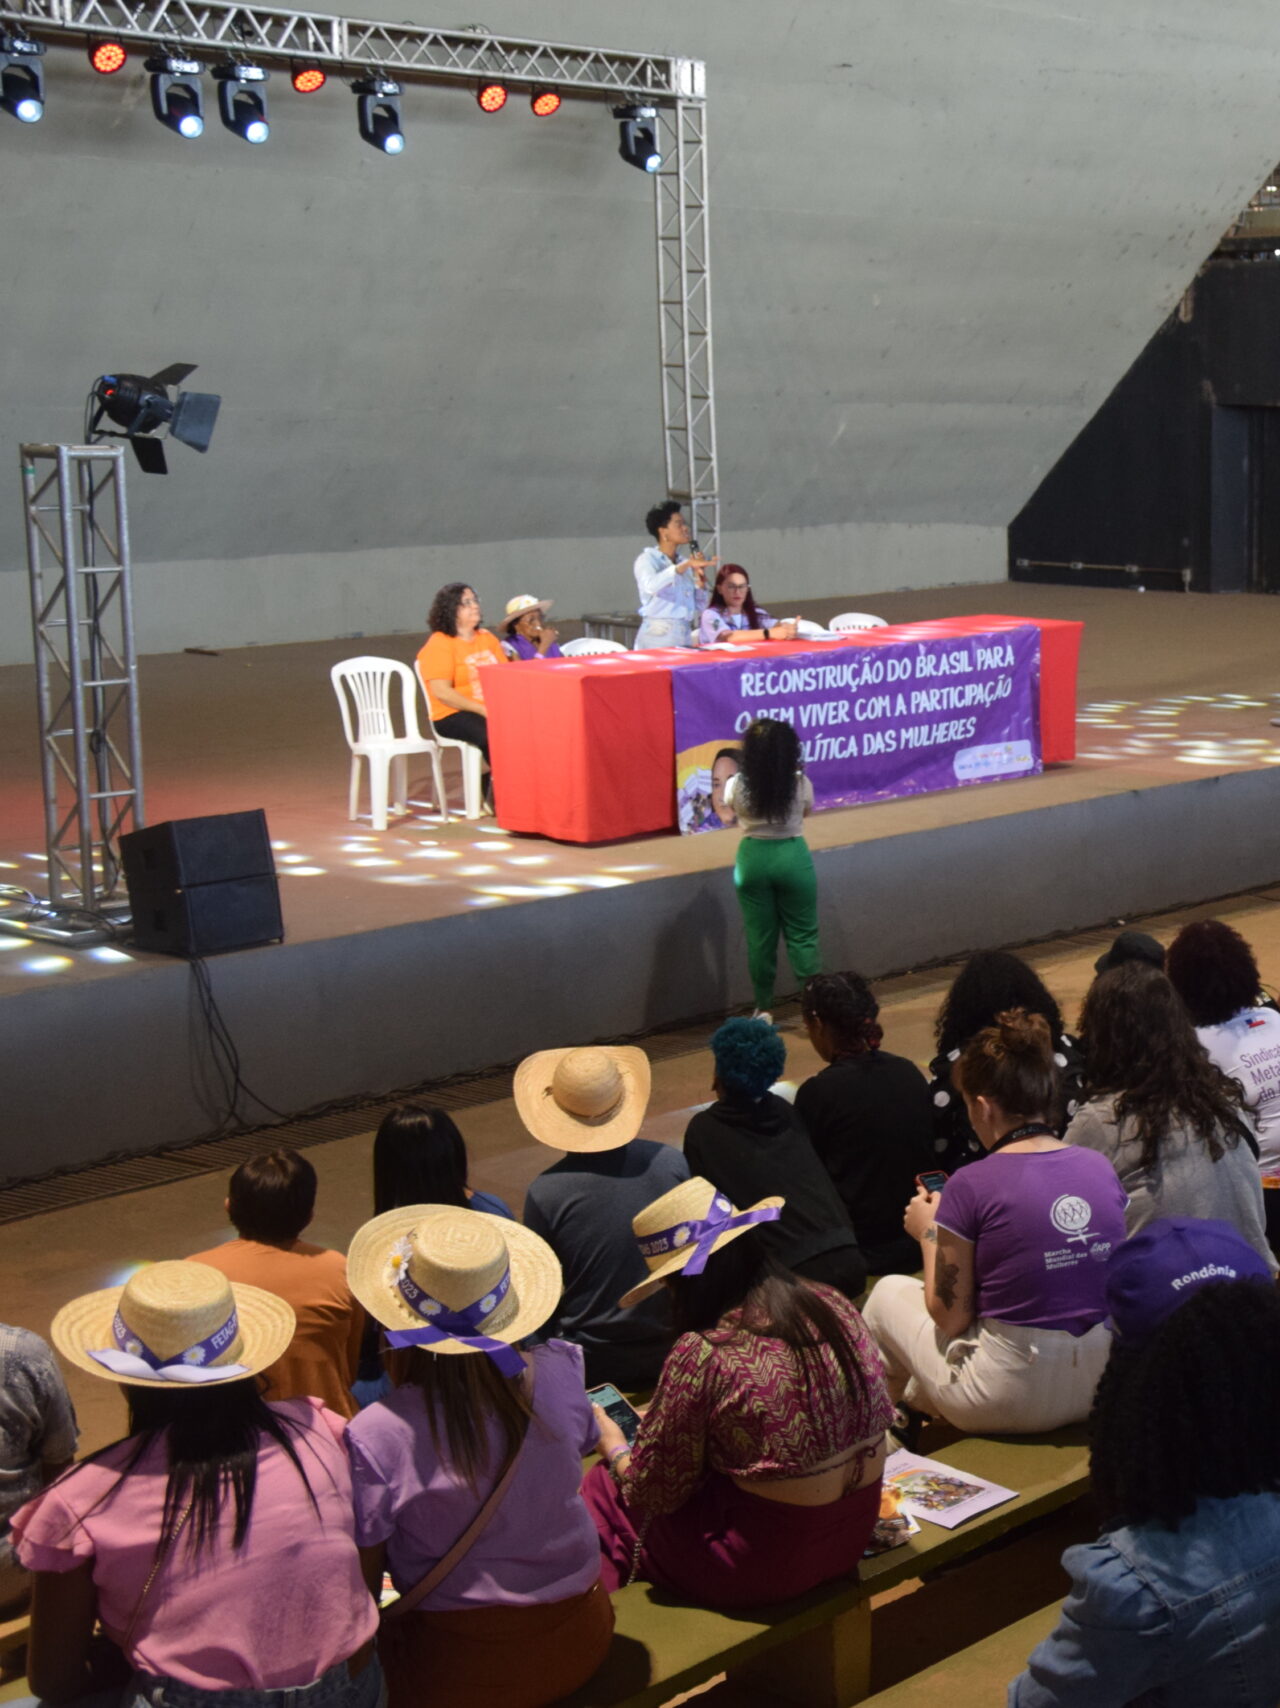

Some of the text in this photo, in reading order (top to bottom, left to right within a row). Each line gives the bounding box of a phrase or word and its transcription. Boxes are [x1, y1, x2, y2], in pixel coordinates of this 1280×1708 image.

[741, 644, 1014, 697] RECONSTRUÇÃO DO BRASIL PARA
[734, 711, 752, 734] O
[799, 700, 850, 728] VIVER
[854, 695, 891, 721] COM
[894, 693, 907, 717] A
[910, 674, 1012, 714] PARTICIPAÇÃO
[797, 716, 976, 763] LÍTICA DAS MULHERES
[1259, 1086, 1276, 1103] do
[1171, 1263, 1237, 1291] Rondônia
